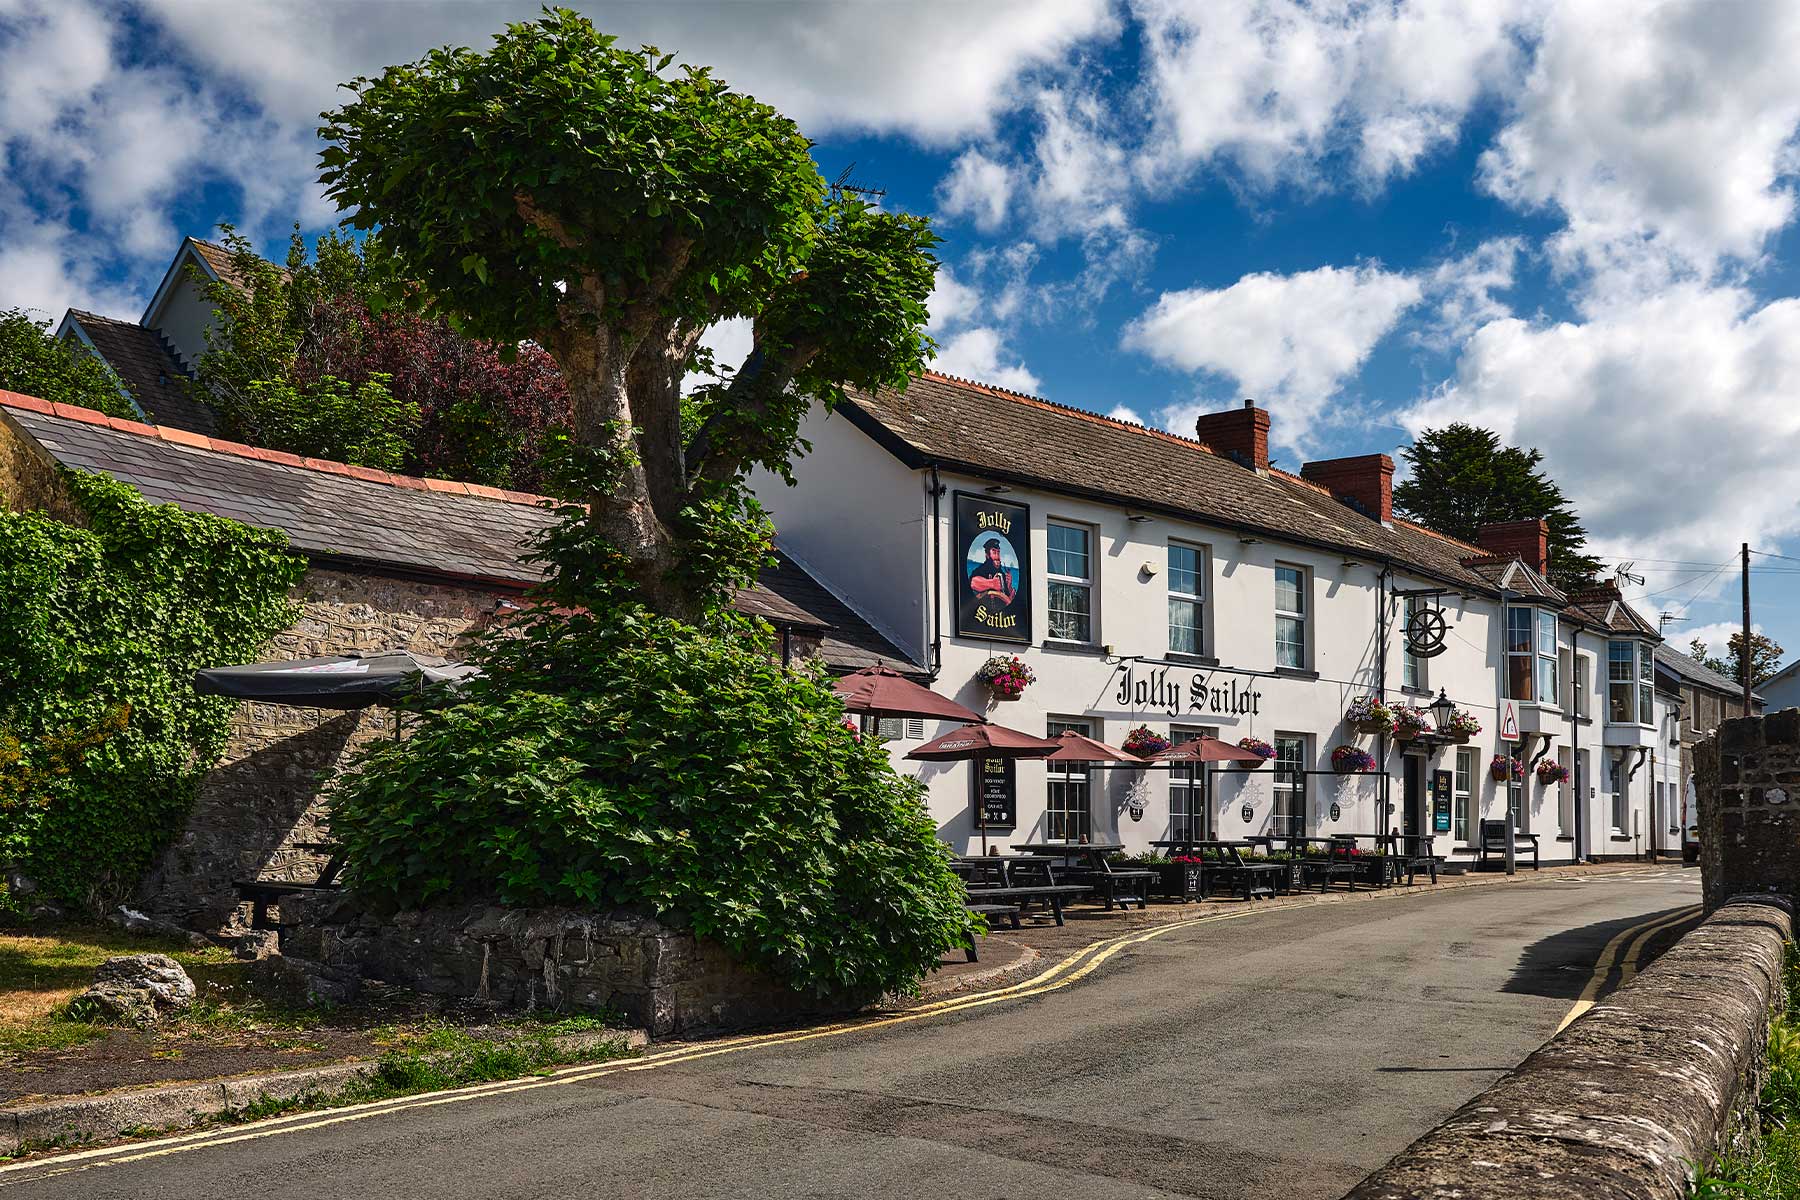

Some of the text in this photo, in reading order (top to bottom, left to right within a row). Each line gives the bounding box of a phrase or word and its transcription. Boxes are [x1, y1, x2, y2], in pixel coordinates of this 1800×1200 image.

[977, 511, 1011, 534] Jolly
[975, 605, 1016, 628] Sailor
[1117, 665, 1261, 717] Jolly Sailor
